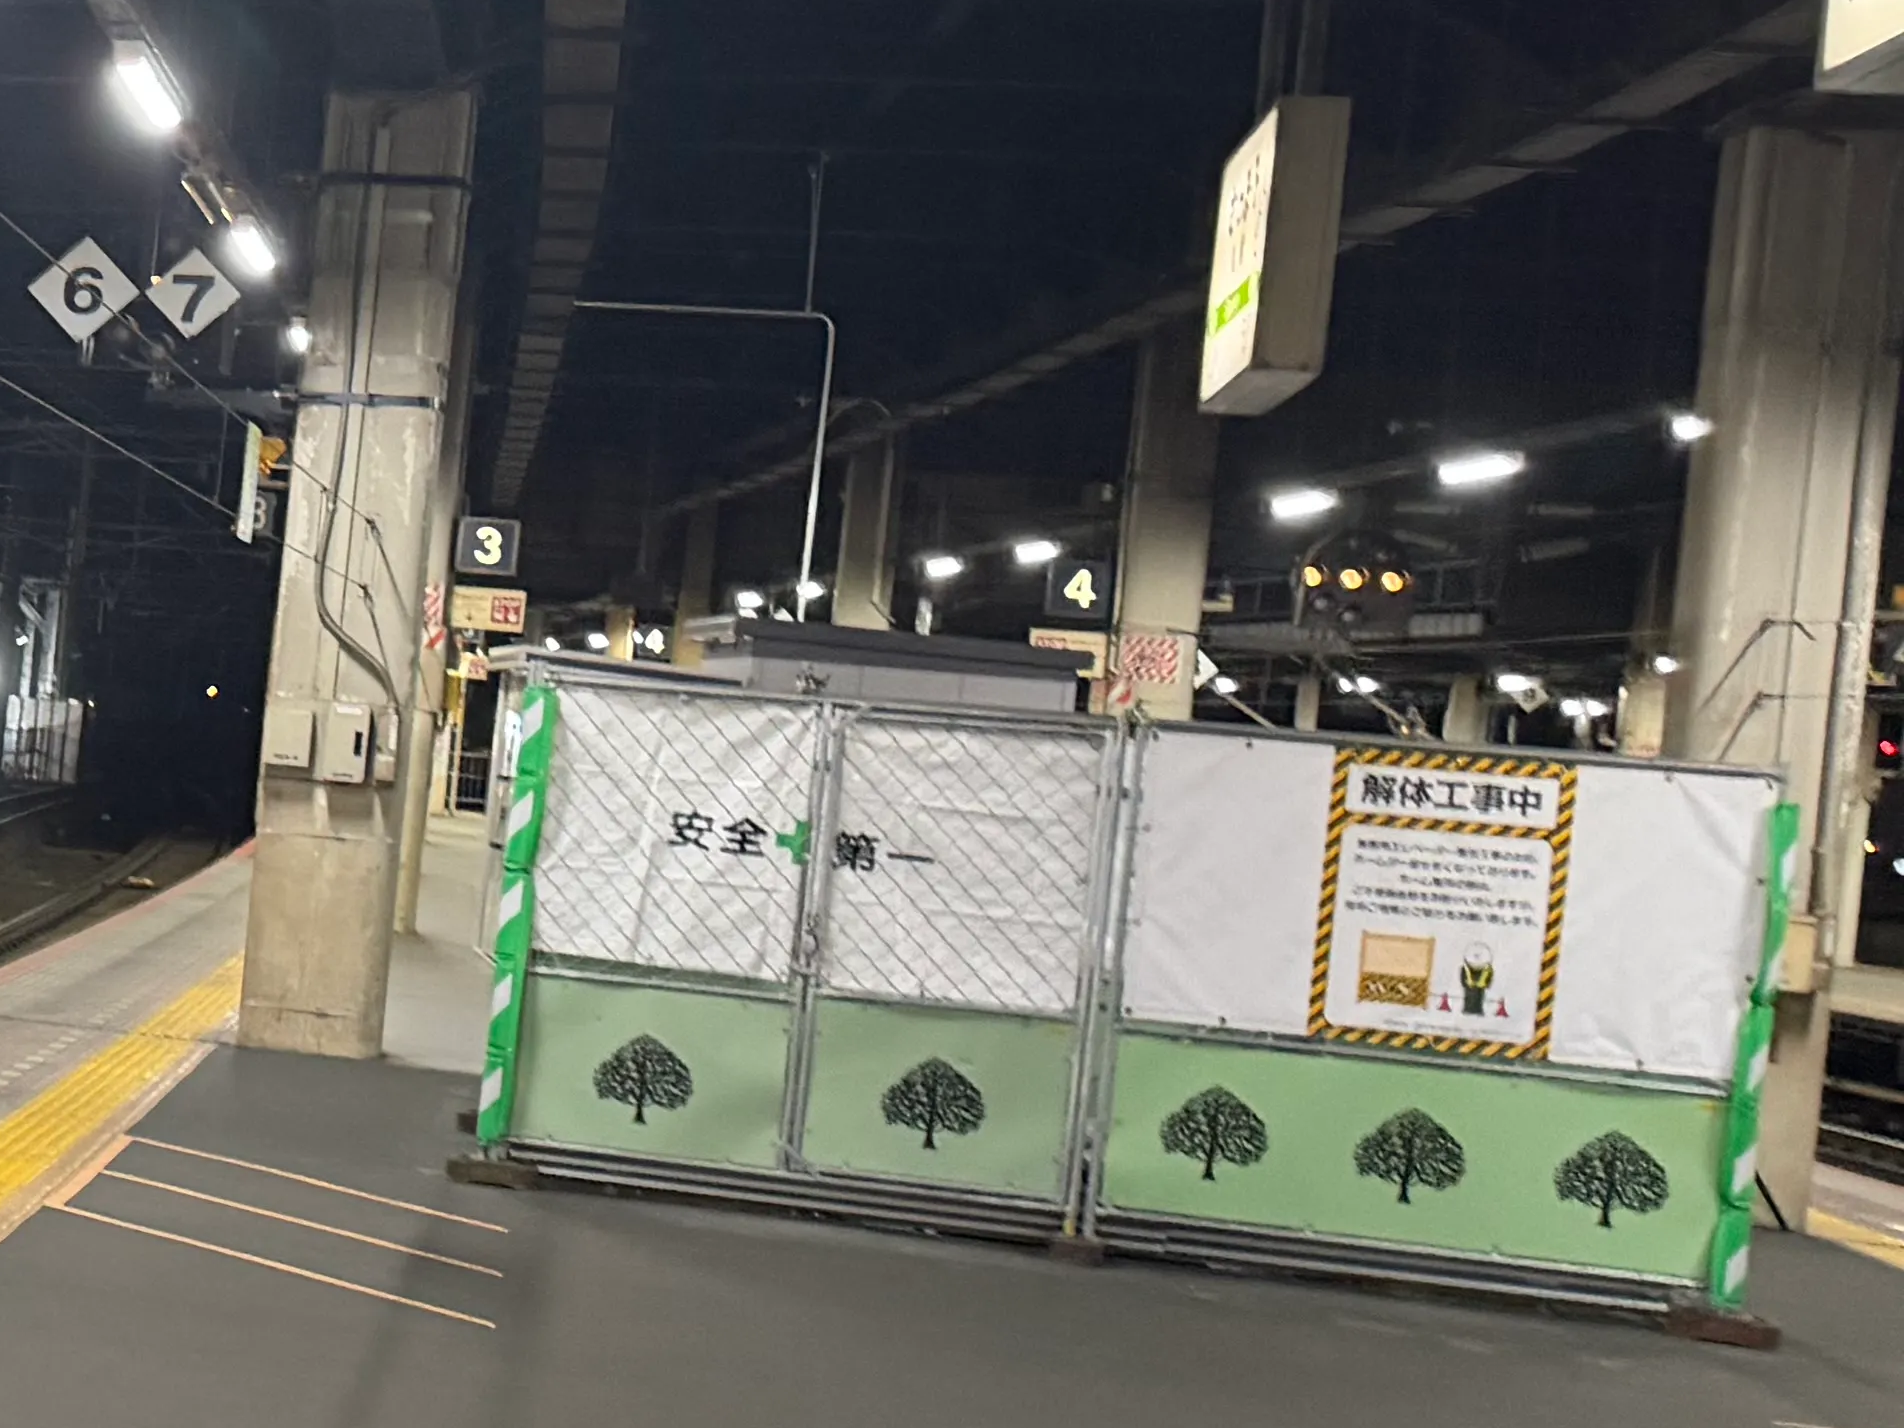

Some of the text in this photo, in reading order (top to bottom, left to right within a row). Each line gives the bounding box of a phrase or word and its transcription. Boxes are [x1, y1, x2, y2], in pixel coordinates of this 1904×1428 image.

[64, 266, 104, 315] 6
[173, 275, 216, 323] 7
[474, 526, 503, 565] 3
[1063, 568, 1097, 609] 4
[1360, 772, 1543, 817] 解体工事中
[668, 811, 935, 872] 安全 第一
